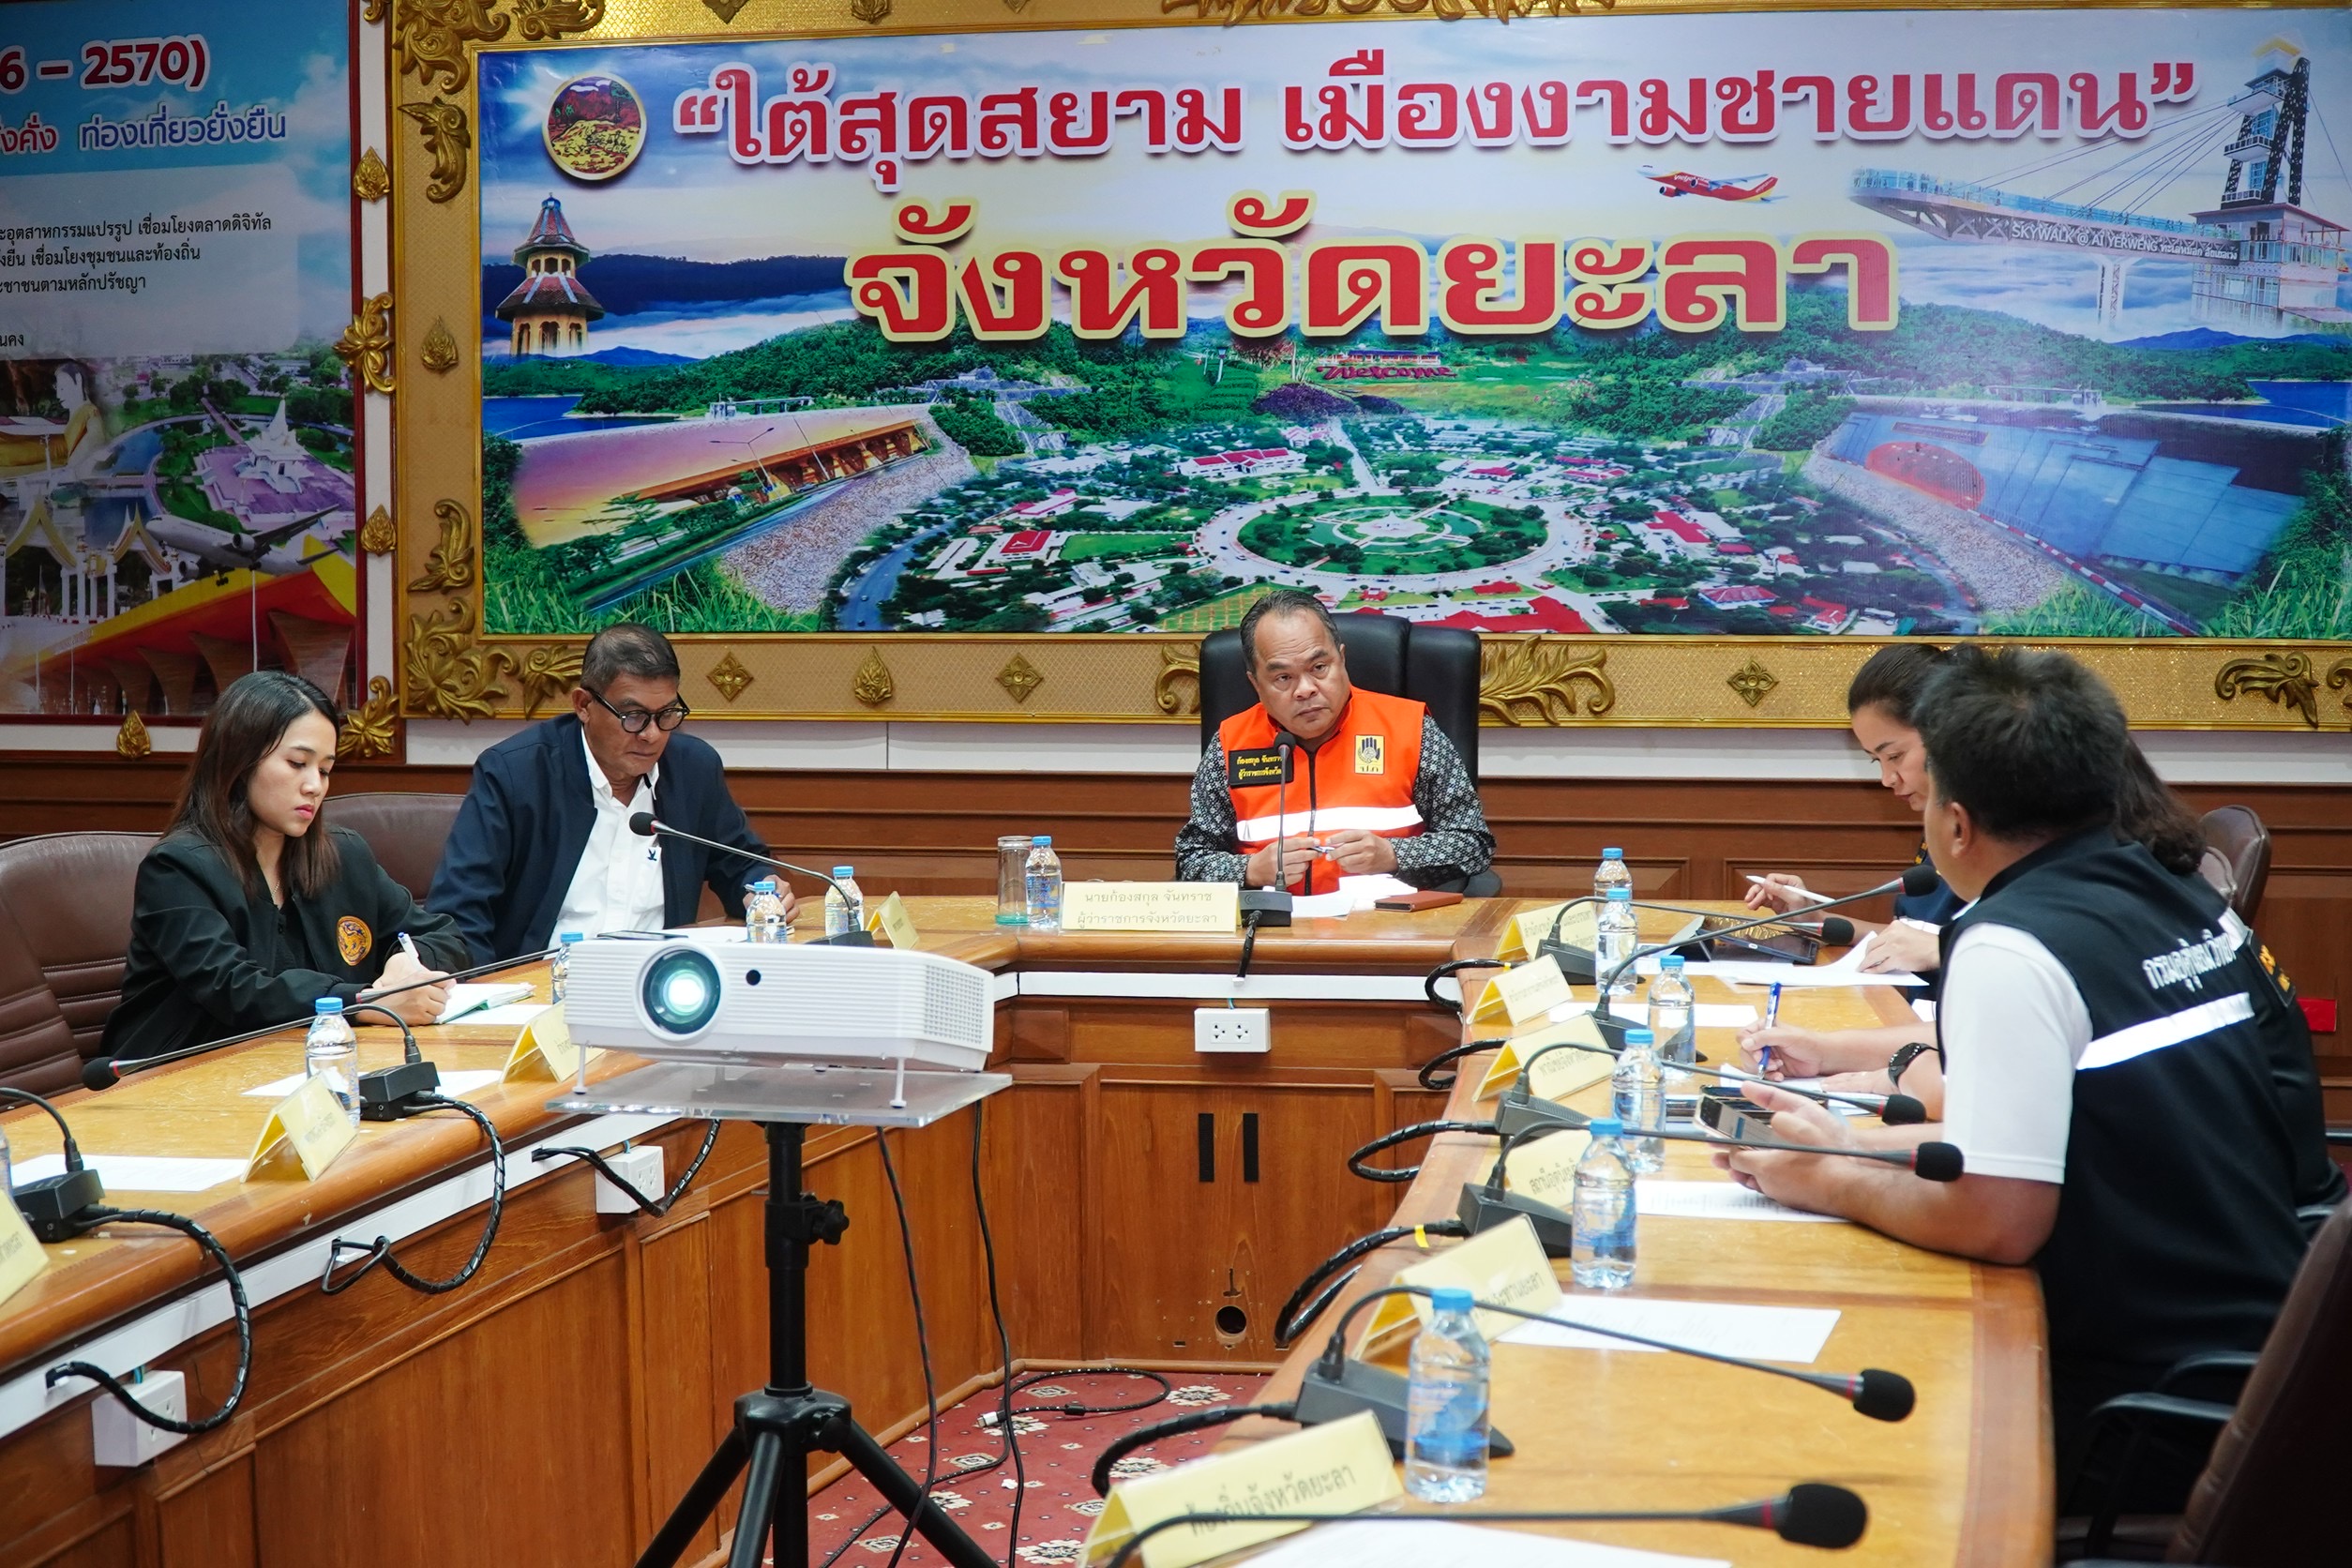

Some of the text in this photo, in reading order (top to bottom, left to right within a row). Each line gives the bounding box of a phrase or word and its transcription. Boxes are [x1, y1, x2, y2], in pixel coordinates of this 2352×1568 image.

[0, 51, 25, 90] 6
[83, 40, 206, 87] 2570)
[0, 102, 286, 152] งคั่ง ท่องเที่ยวยั่งยืน
[680, 49, 2192, 186] “ใต้สุดสยาม เมืองงามชายแดน”
[138, 212, 272, 236] เชื่อมโยงตลาดดิจิทัล
[2011, 223, 2073, 245] SKYWALK
[2076, 232, 2090, 246] @
[2108, 234, 2158, 252] YERWENG
[0, 239, 201, 268] งยืน เชื่อมโยงชุมชนและท้องถิ่น
[850, 196, 1886, 336] จังหวัดยะลา
[1316, 366, 1457, 380] Welcome
[1085, 888, 1159, 907] นายก้องสกุล
[1078, 910, 1218, 930] ผู้ว่าราชการจังหวัดยะลา
